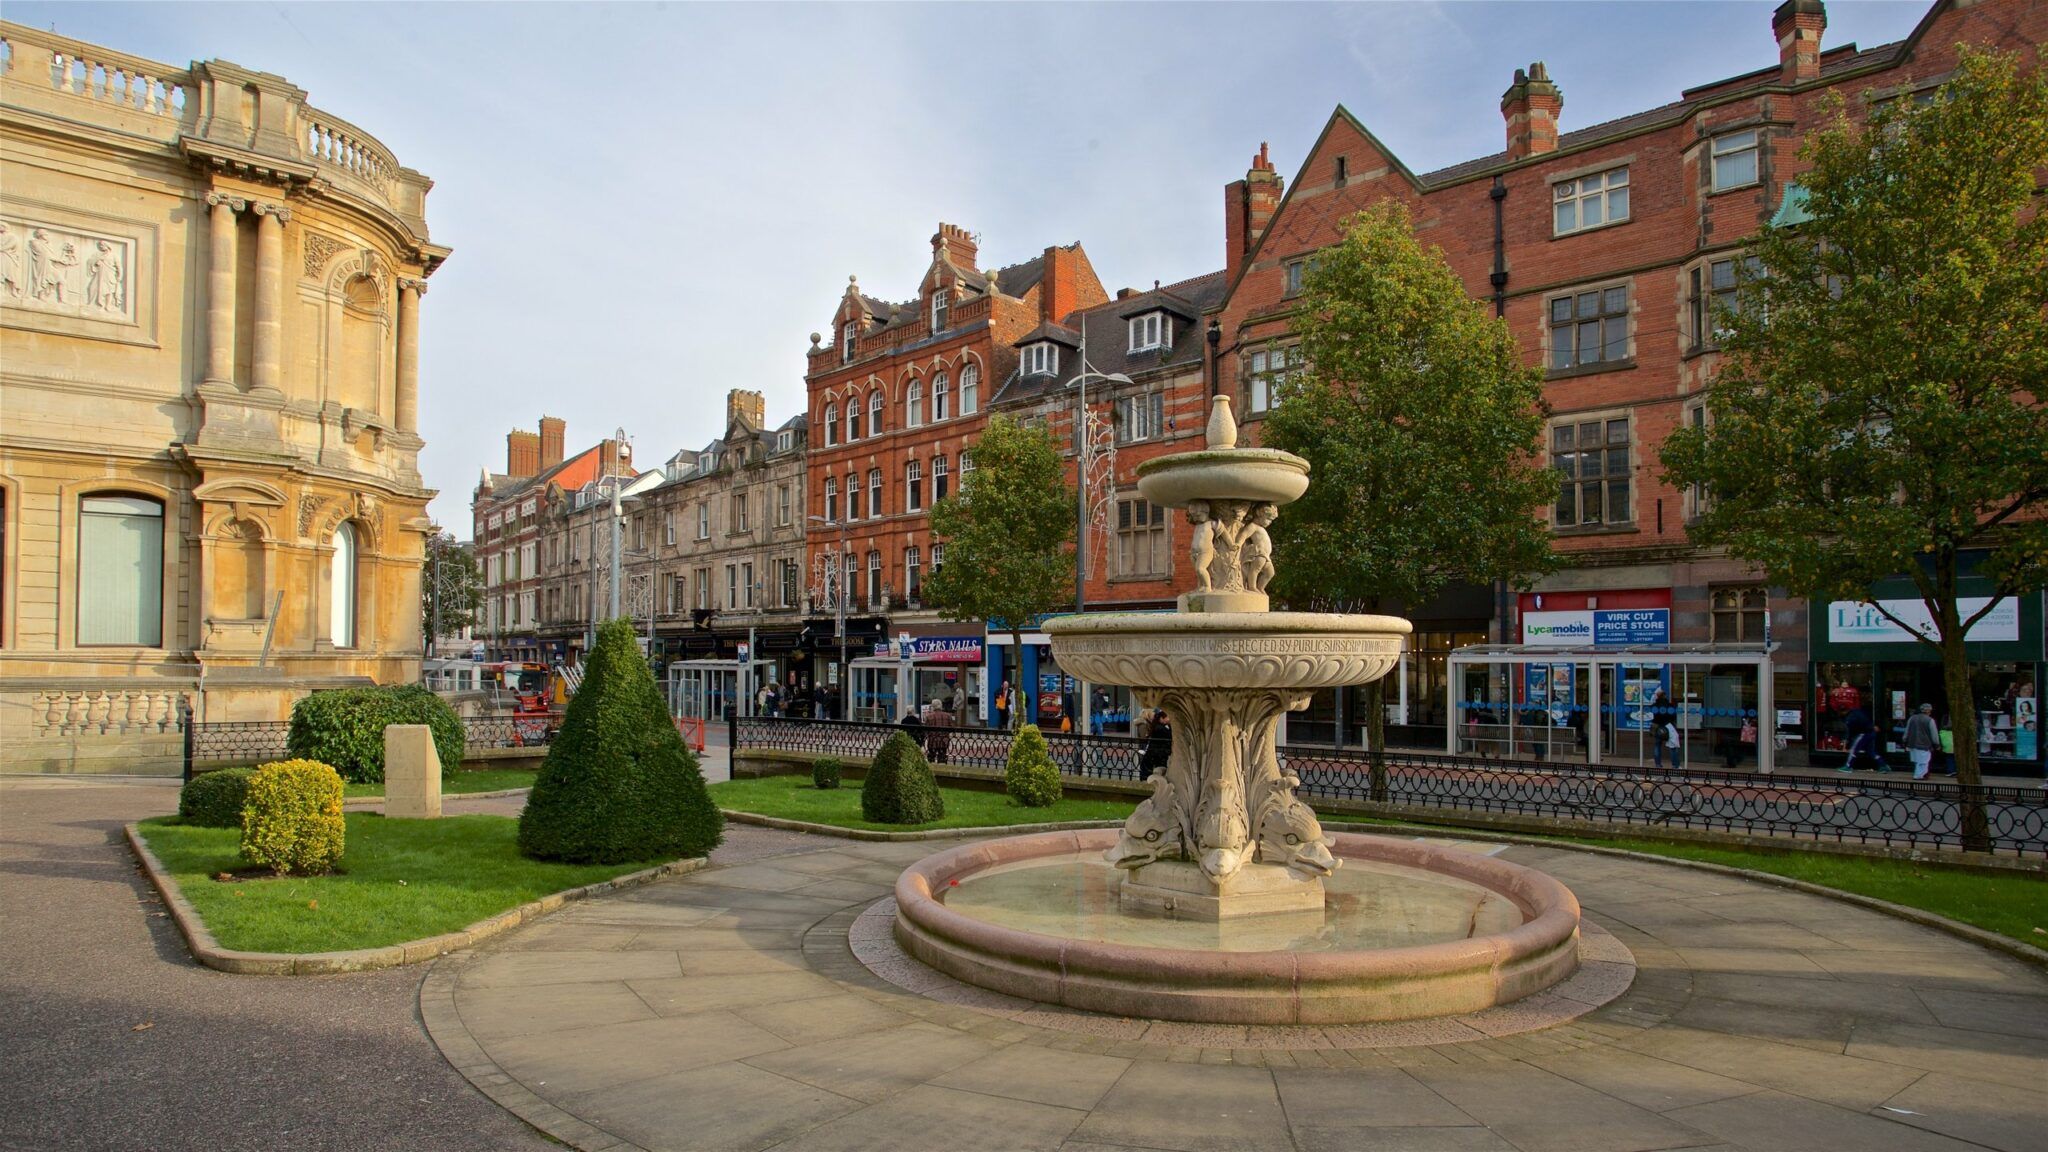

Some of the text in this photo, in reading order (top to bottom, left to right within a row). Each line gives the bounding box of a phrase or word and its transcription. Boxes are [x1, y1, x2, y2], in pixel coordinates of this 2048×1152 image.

[1607, 612, 1654, 621] VIRK CUT
[1836, 608, 1888, 628] Life
[1527, 624, 1590, 635] Lycamobile
[1598, 621, 1665, 630] PRICE STORE
[949, 640, 977, 652] NAILS
[1208, 640, 1229, 652] WAS
[1232, 640, 1277, 653] ERECTED
[1279, 640, 1292, 653] BY
[1293, 640, 1323, 652] PUBLIC
